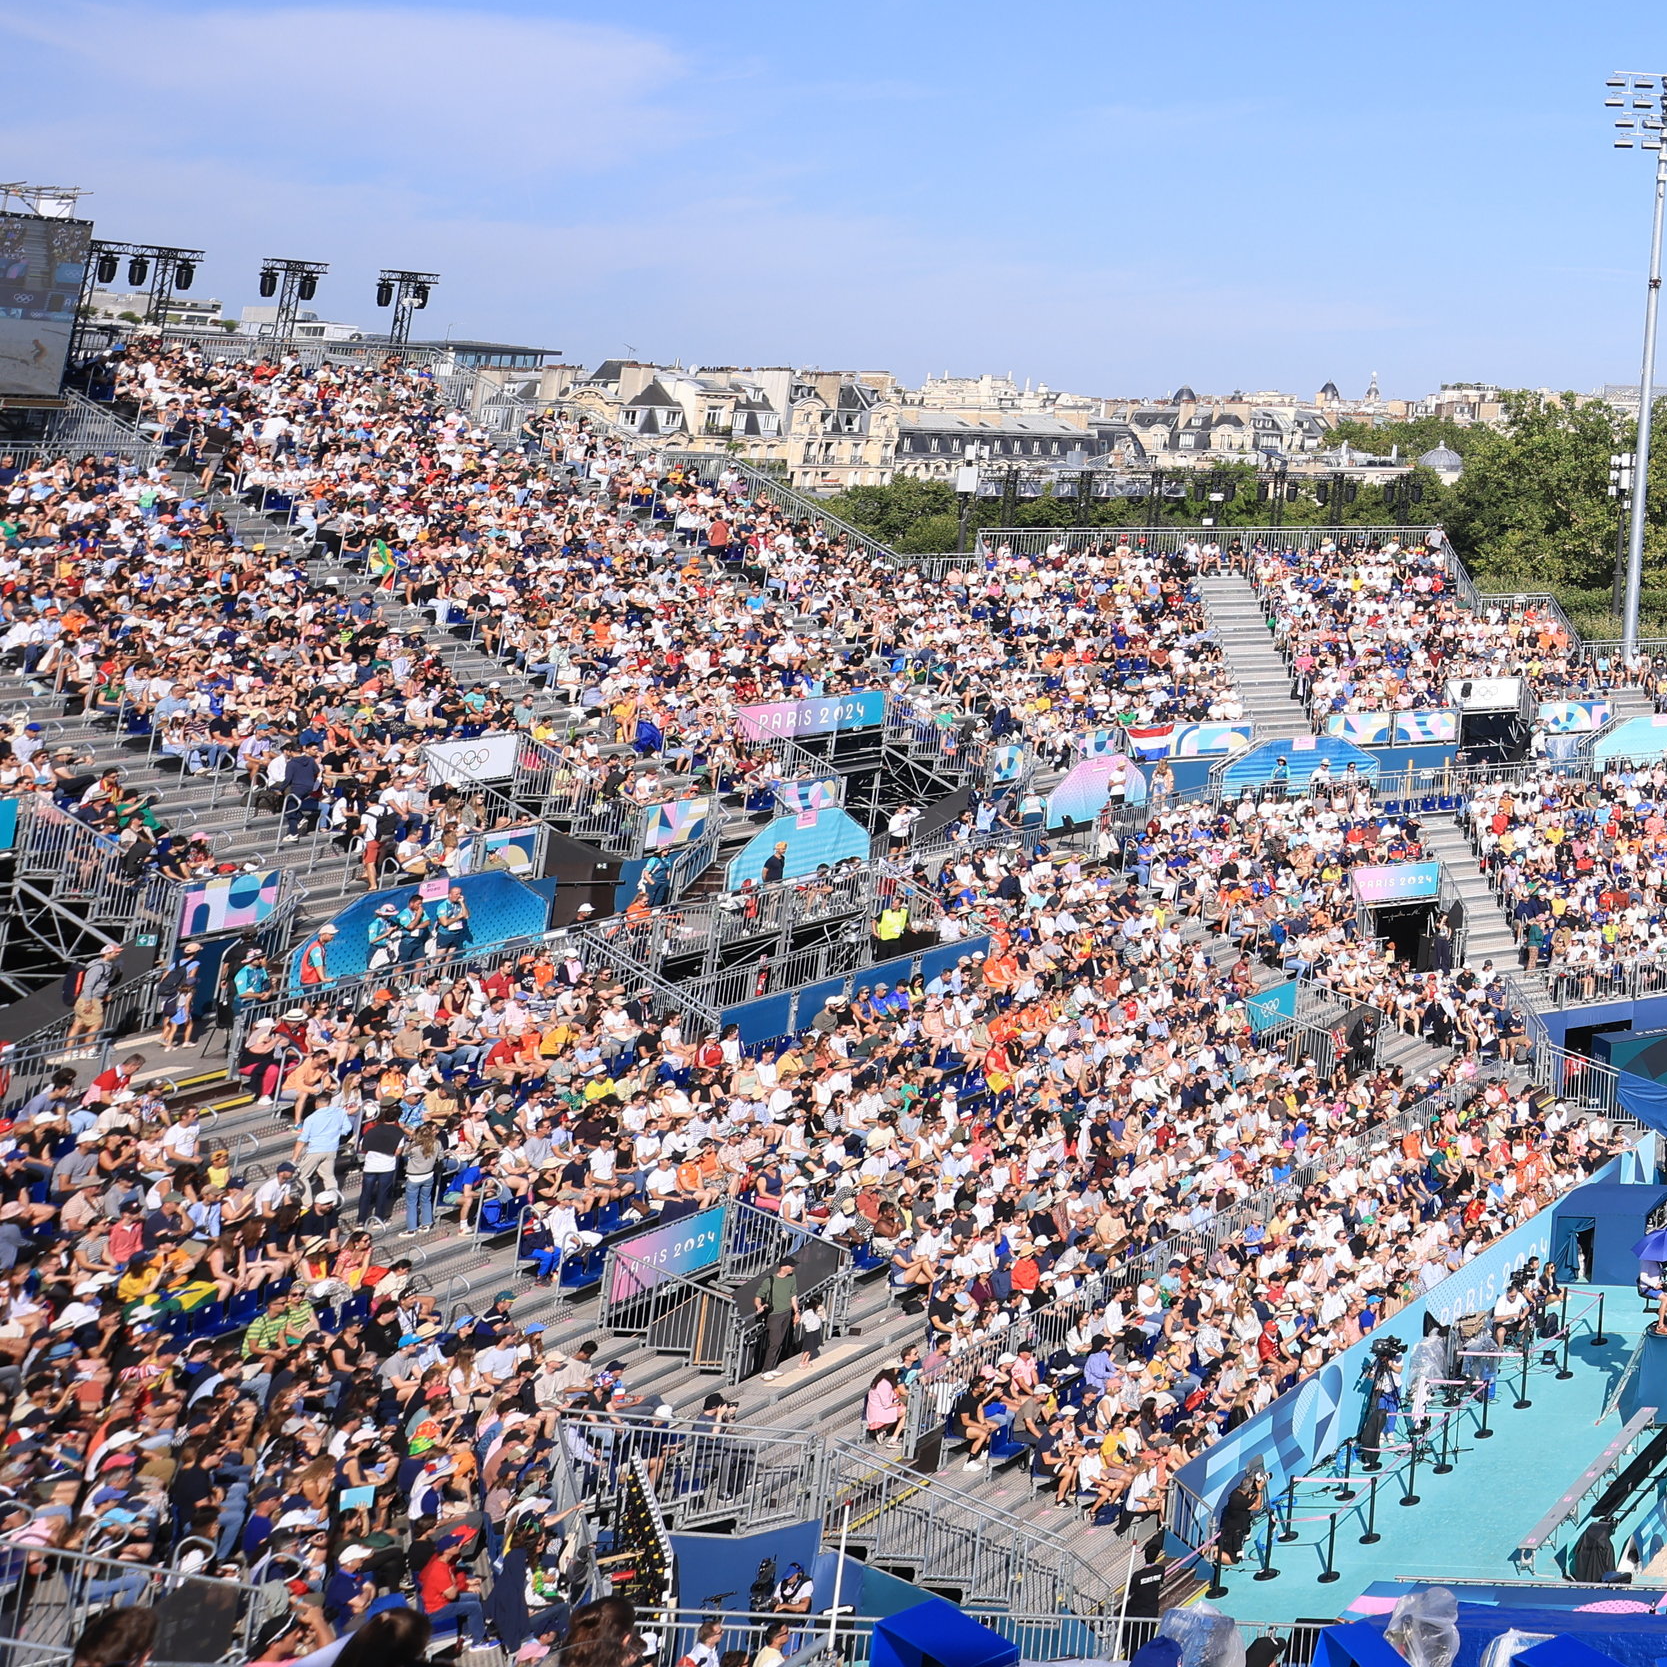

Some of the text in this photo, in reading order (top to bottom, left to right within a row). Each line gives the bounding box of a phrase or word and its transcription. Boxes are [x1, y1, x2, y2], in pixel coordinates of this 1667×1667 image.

[819, 702, 865, 724] 2024
[1399, 875, 1433, 886] 2024
[673, 1230, 715, 1258] 2024
